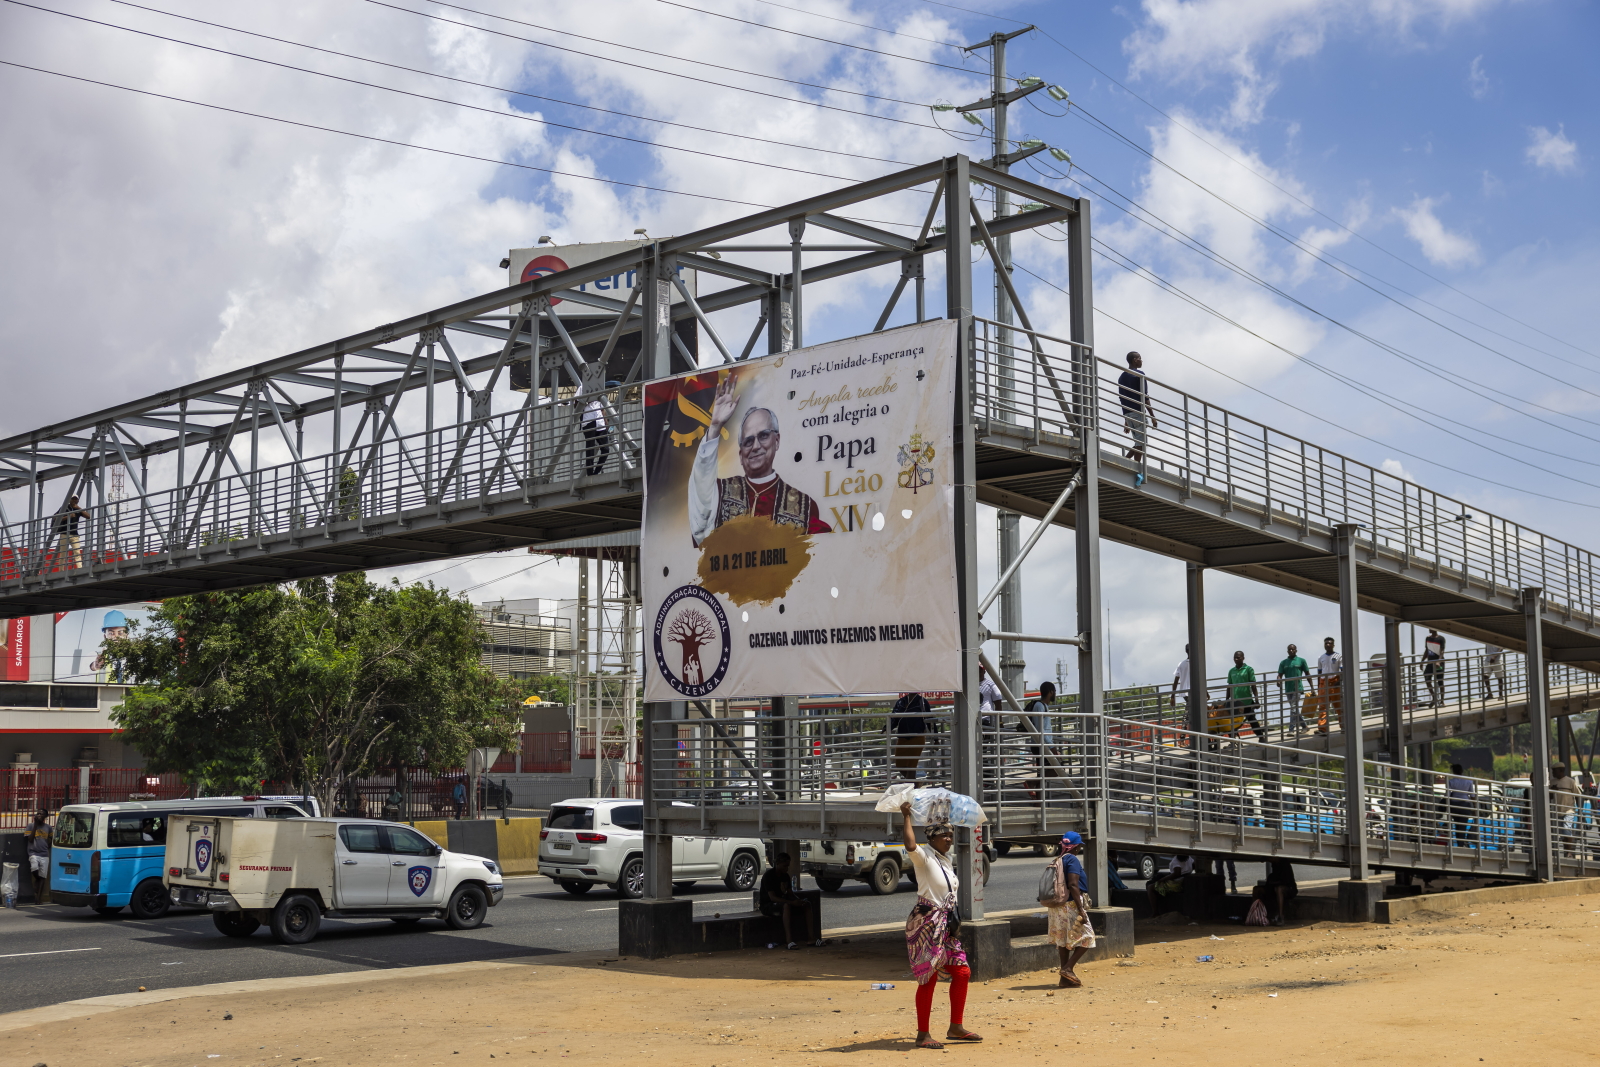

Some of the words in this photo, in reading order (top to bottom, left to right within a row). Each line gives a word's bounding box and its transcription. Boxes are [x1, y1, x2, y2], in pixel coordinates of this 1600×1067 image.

[790, 346, 925, 379] Paz-Fé-Unidade-Esperança
[798, 385, 853, 413] Angola
[857, 376, 898, 398] recebe
[802, 413, 829, 428] com
[833, 403, 877, 425] alegria
[881, 404, 890, 414] o
[816, 434, 877, 469] Papa
[823, 469, 883, 497] Leão
[829, 503, 872, 534] XIV
[710, 555, 720, 572] 18
[723, 554, 729, 571] A
[732, 553, 742, 570] 21
[745, 551, 757, 568] DE
[760, 548, 788, 566] ABRIL
[655, 587, 698, 636] ADMINISTRAÇÃO
[699, 590, 728, 632] MUNICIPAL
[15, 619, 24, 667] SANITÁRIOS
[749, 631, 789, 648] CAZENGA
[791, 629, 828, 645] JUNTOS
[830, 626, 877, 643] FAZEMOS
[879, 623, 924, 641] MELHOR
[670, 677, 720, 696] CAZENGA
